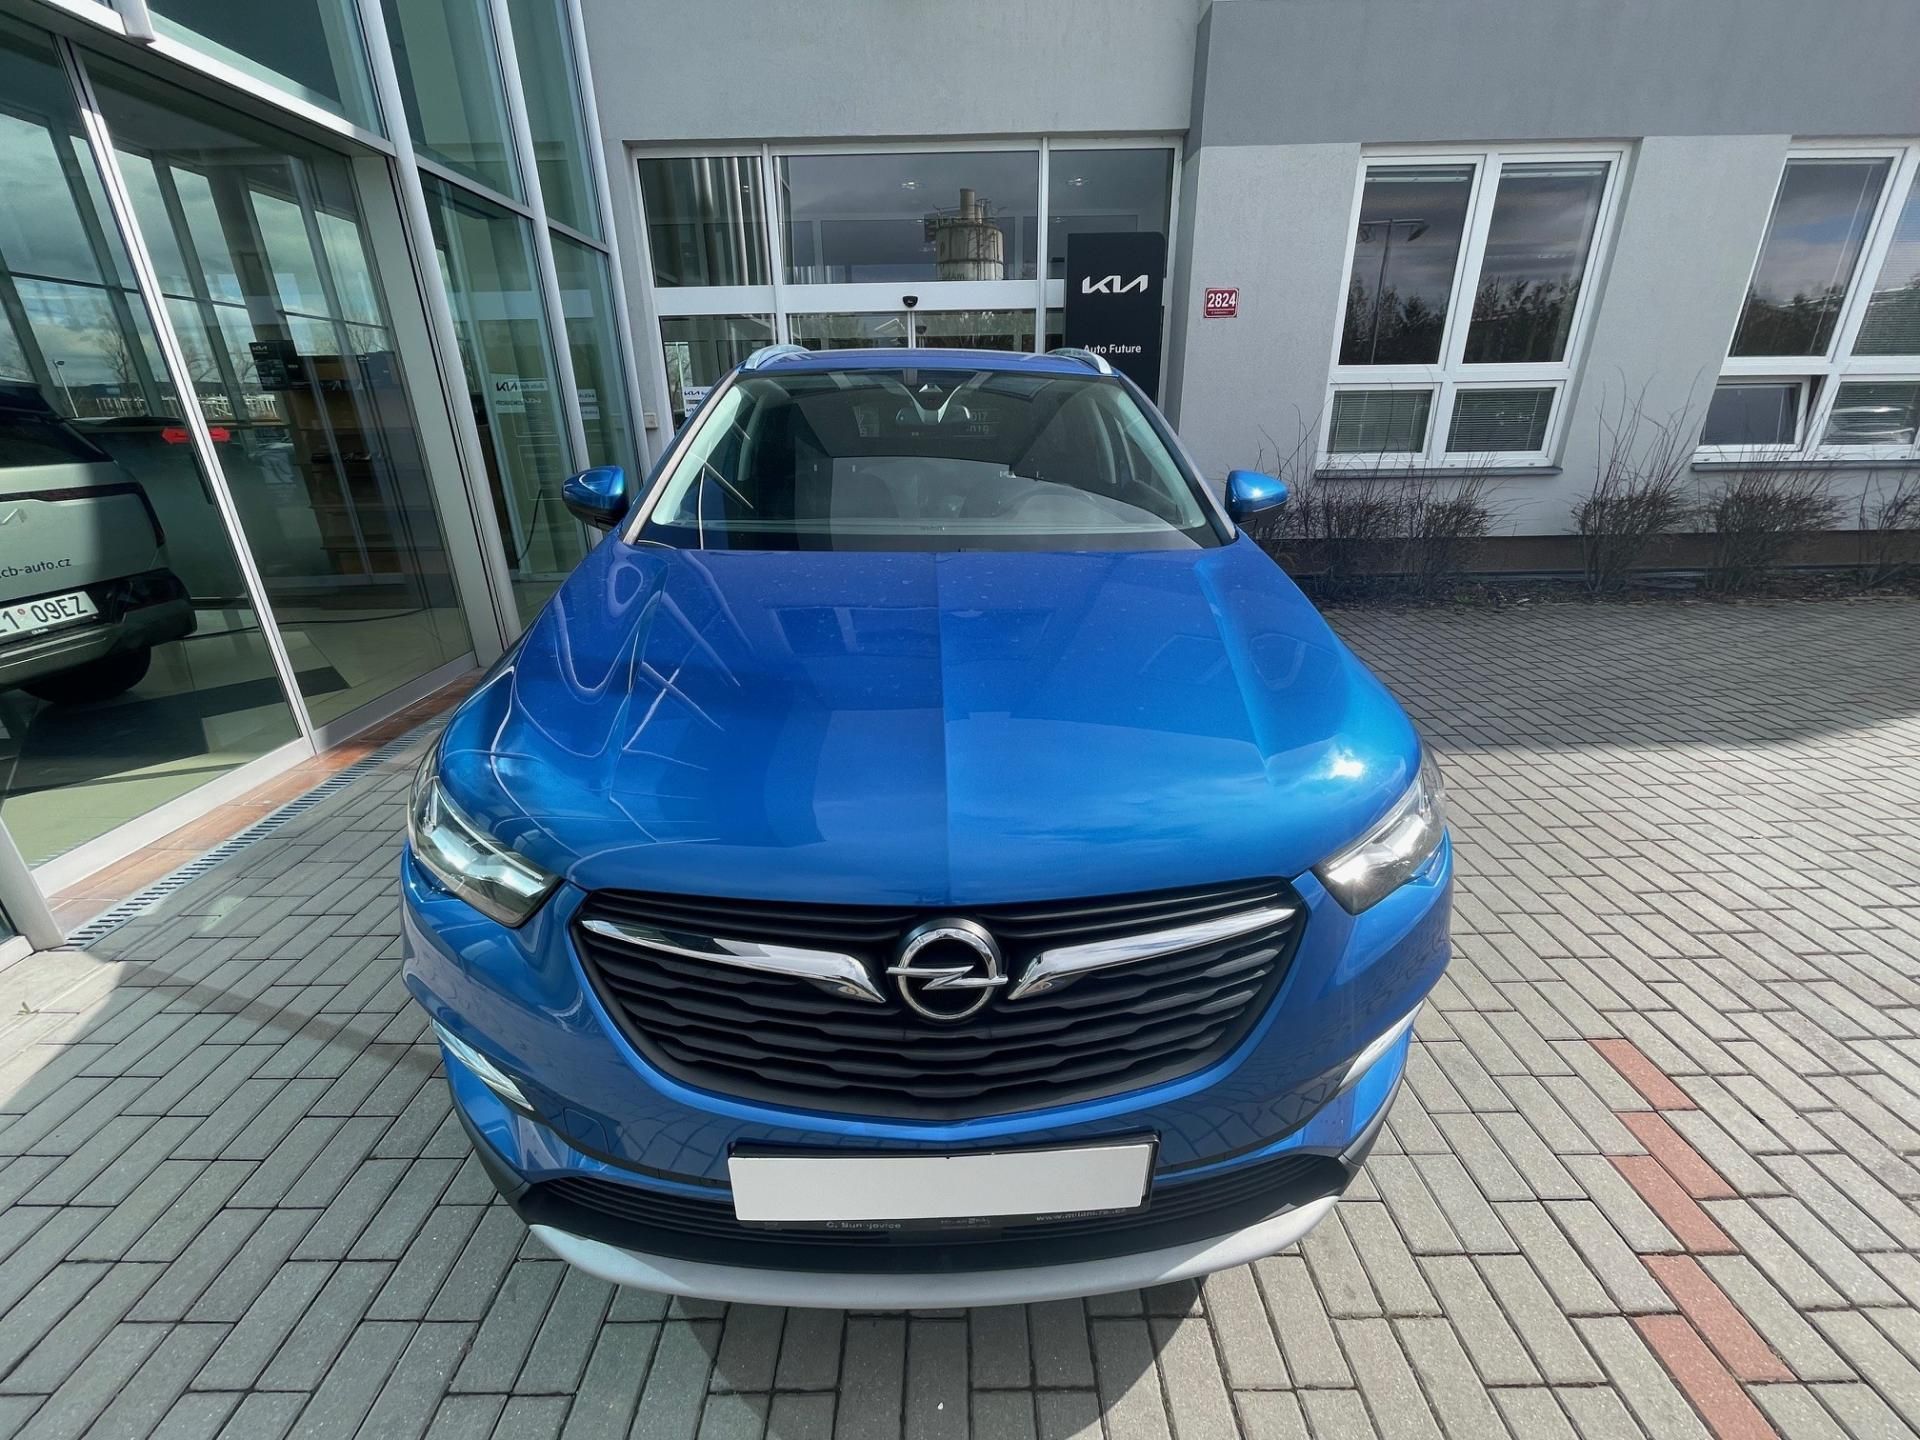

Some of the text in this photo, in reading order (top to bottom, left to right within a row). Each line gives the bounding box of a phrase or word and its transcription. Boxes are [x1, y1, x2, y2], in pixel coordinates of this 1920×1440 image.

[1082, 274, 1149, 294] KIA
[1207, 292, 1236, 308] 2824
[1083, 344, 1142, 354] Auto Future
[30, 595, 88, 623] 09EZ
